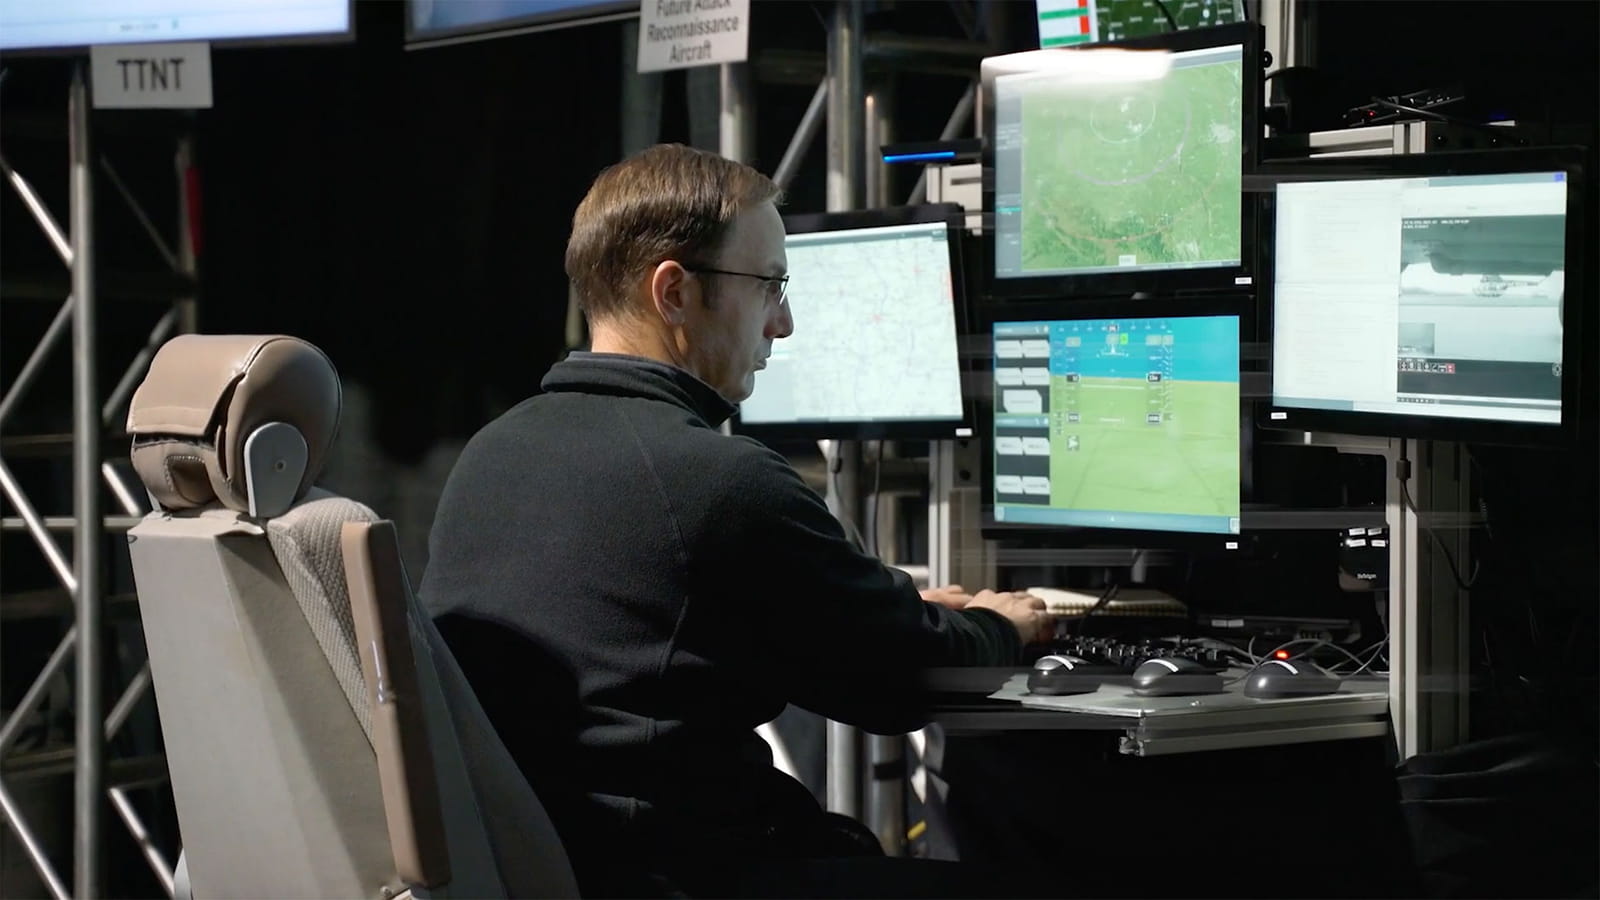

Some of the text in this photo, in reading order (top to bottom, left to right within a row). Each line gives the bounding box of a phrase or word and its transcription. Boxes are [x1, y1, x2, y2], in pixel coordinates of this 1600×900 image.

[657, 0, 692, 17] Future
[647, 16, 739, 42] Reconnaissance
[669, 39, 712, 62] Aircraft
[116, 58, 184, 91] TTNT
